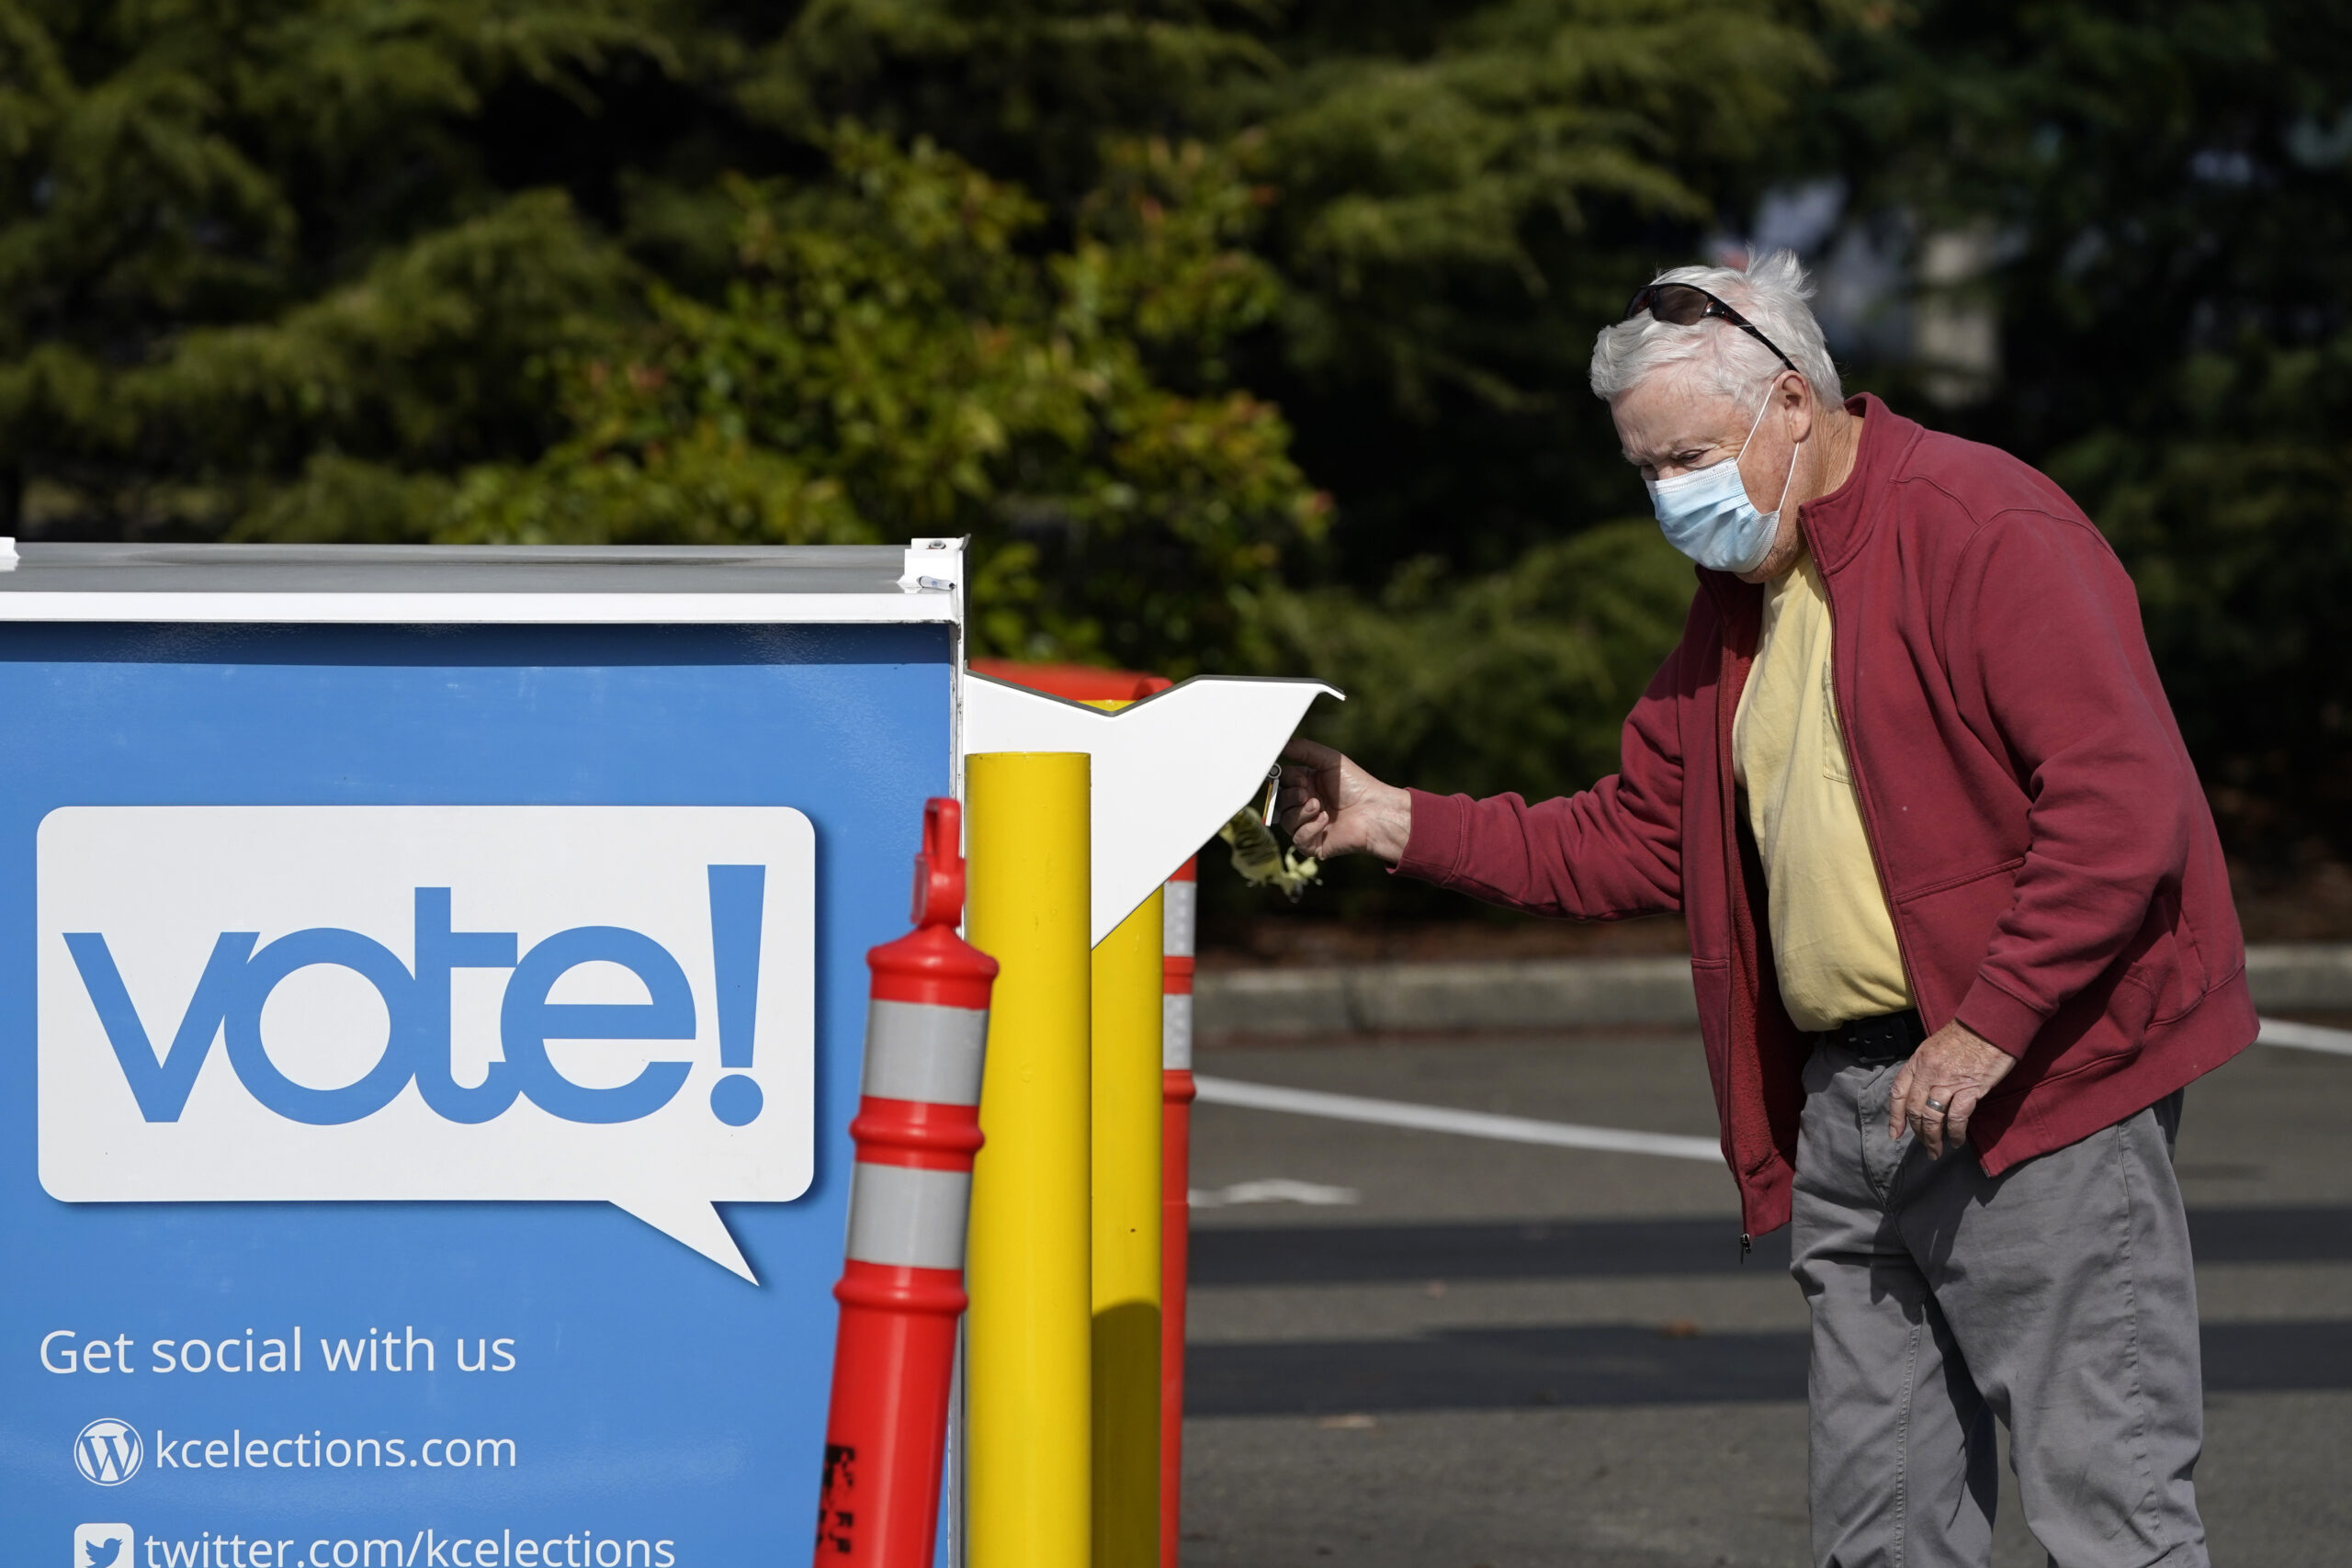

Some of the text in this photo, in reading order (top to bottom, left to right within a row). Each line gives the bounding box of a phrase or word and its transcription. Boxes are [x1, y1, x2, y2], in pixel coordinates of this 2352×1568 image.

[62, 863, 766, 1127] vote!
[40, 1325, 516, 1374] Get social with us
[156, 1428, 516, 1469] kcelections.com
[144, 1529, 675, 1568] twitter.com/kcelections
